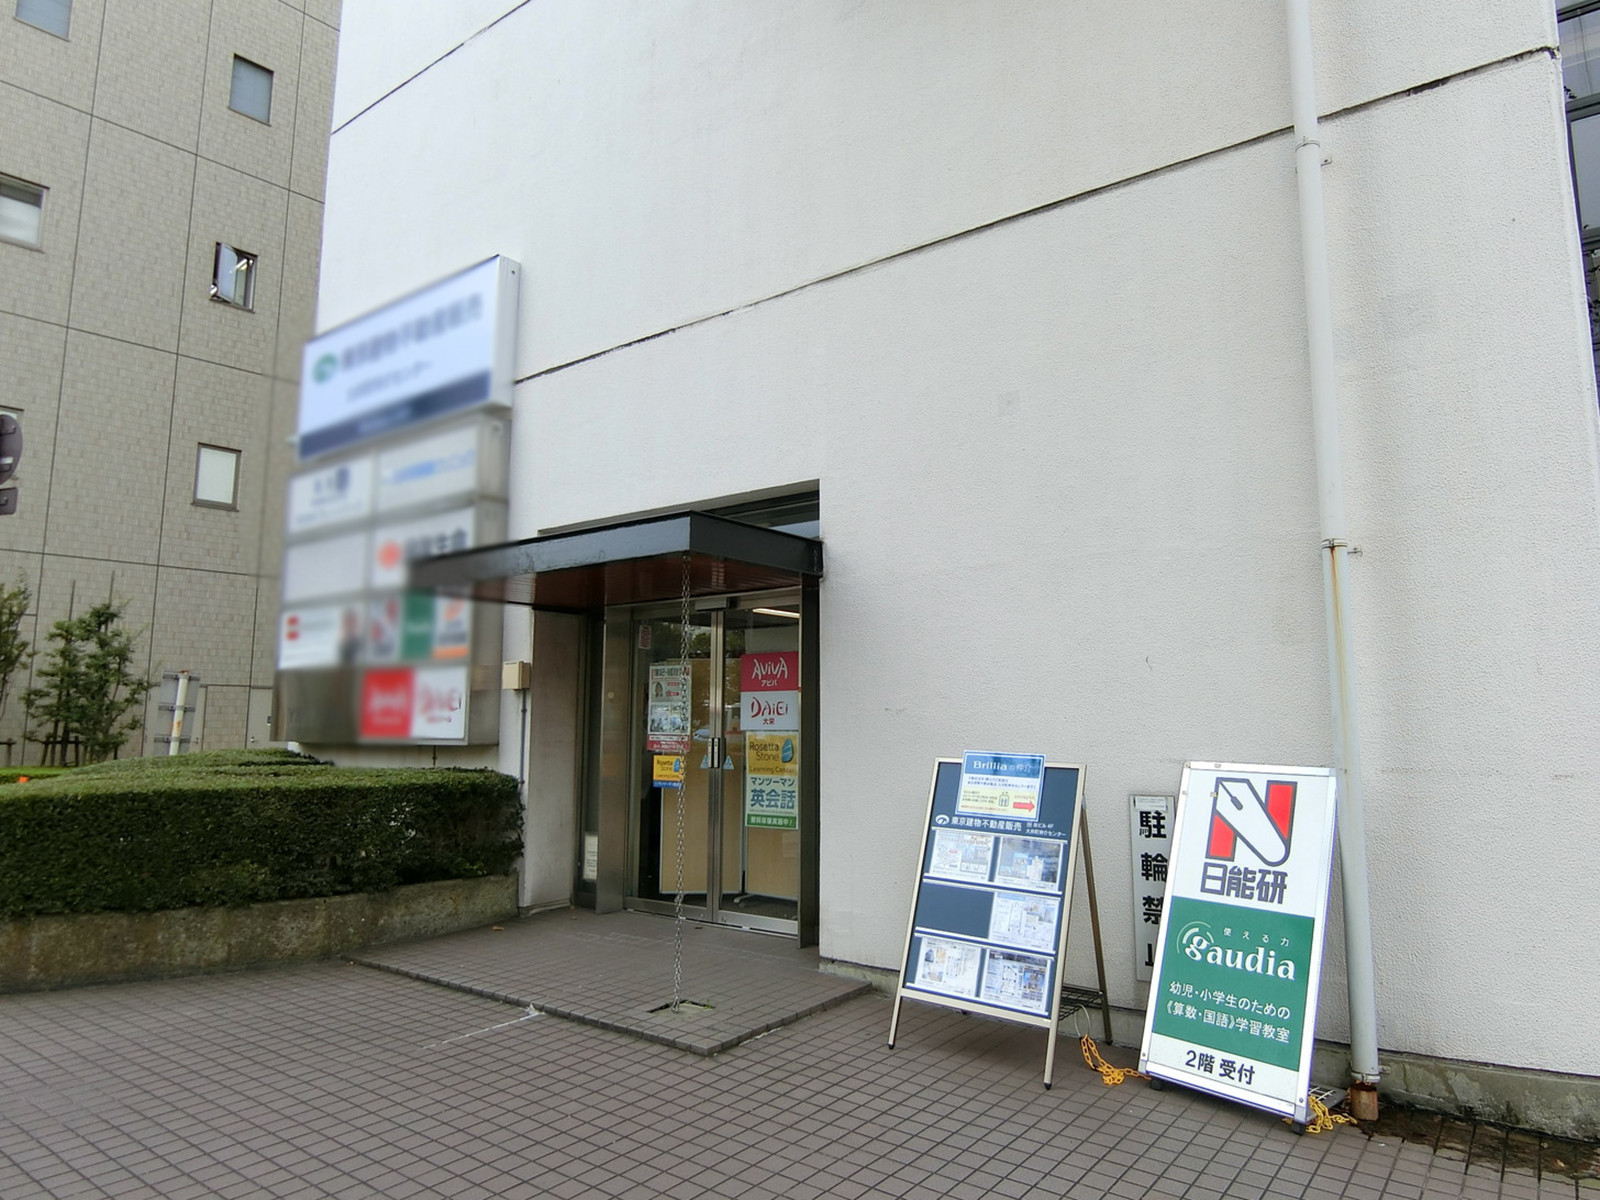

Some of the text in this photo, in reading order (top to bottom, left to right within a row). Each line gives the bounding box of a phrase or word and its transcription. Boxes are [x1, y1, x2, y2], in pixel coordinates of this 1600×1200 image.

[749, 741, 780, 752] Rosetta
[756, 751, 780, 762] Stone
[750, 766, 774, 774] Learning
[750, 777, 795, 787] マンツーマン
[751, 788, 796, 809] 英会話
[951, 817, 1022, 832] 東京建物不動産販売
[1199, 862, 1288, 905] 日能研
[1184, 935, 1295, 981] gaudia
[1169, 981, 1290, 1020] 幼児・小学生のための
[1185, 1049, 1255, 1085] 2階 受付
